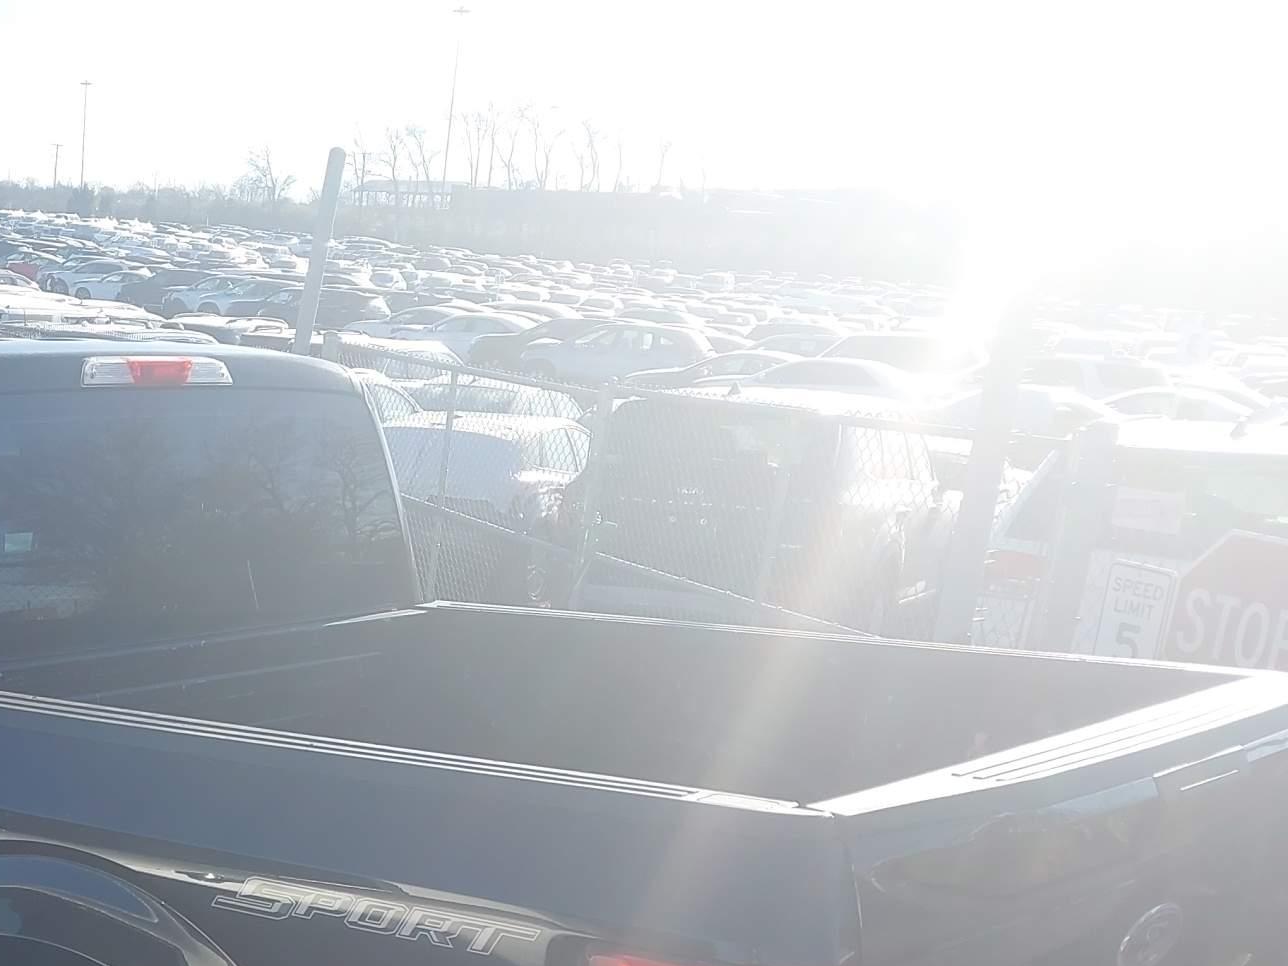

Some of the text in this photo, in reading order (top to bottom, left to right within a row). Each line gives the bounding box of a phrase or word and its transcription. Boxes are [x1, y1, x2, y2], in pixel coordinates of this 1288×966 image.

[1112, 576, 1164, 602] SPEED
[1113, 596, 1156, 621] LIMIT
[1115, 622, 1141, 659] 5
[211, 875, 542, 956] SPORT
